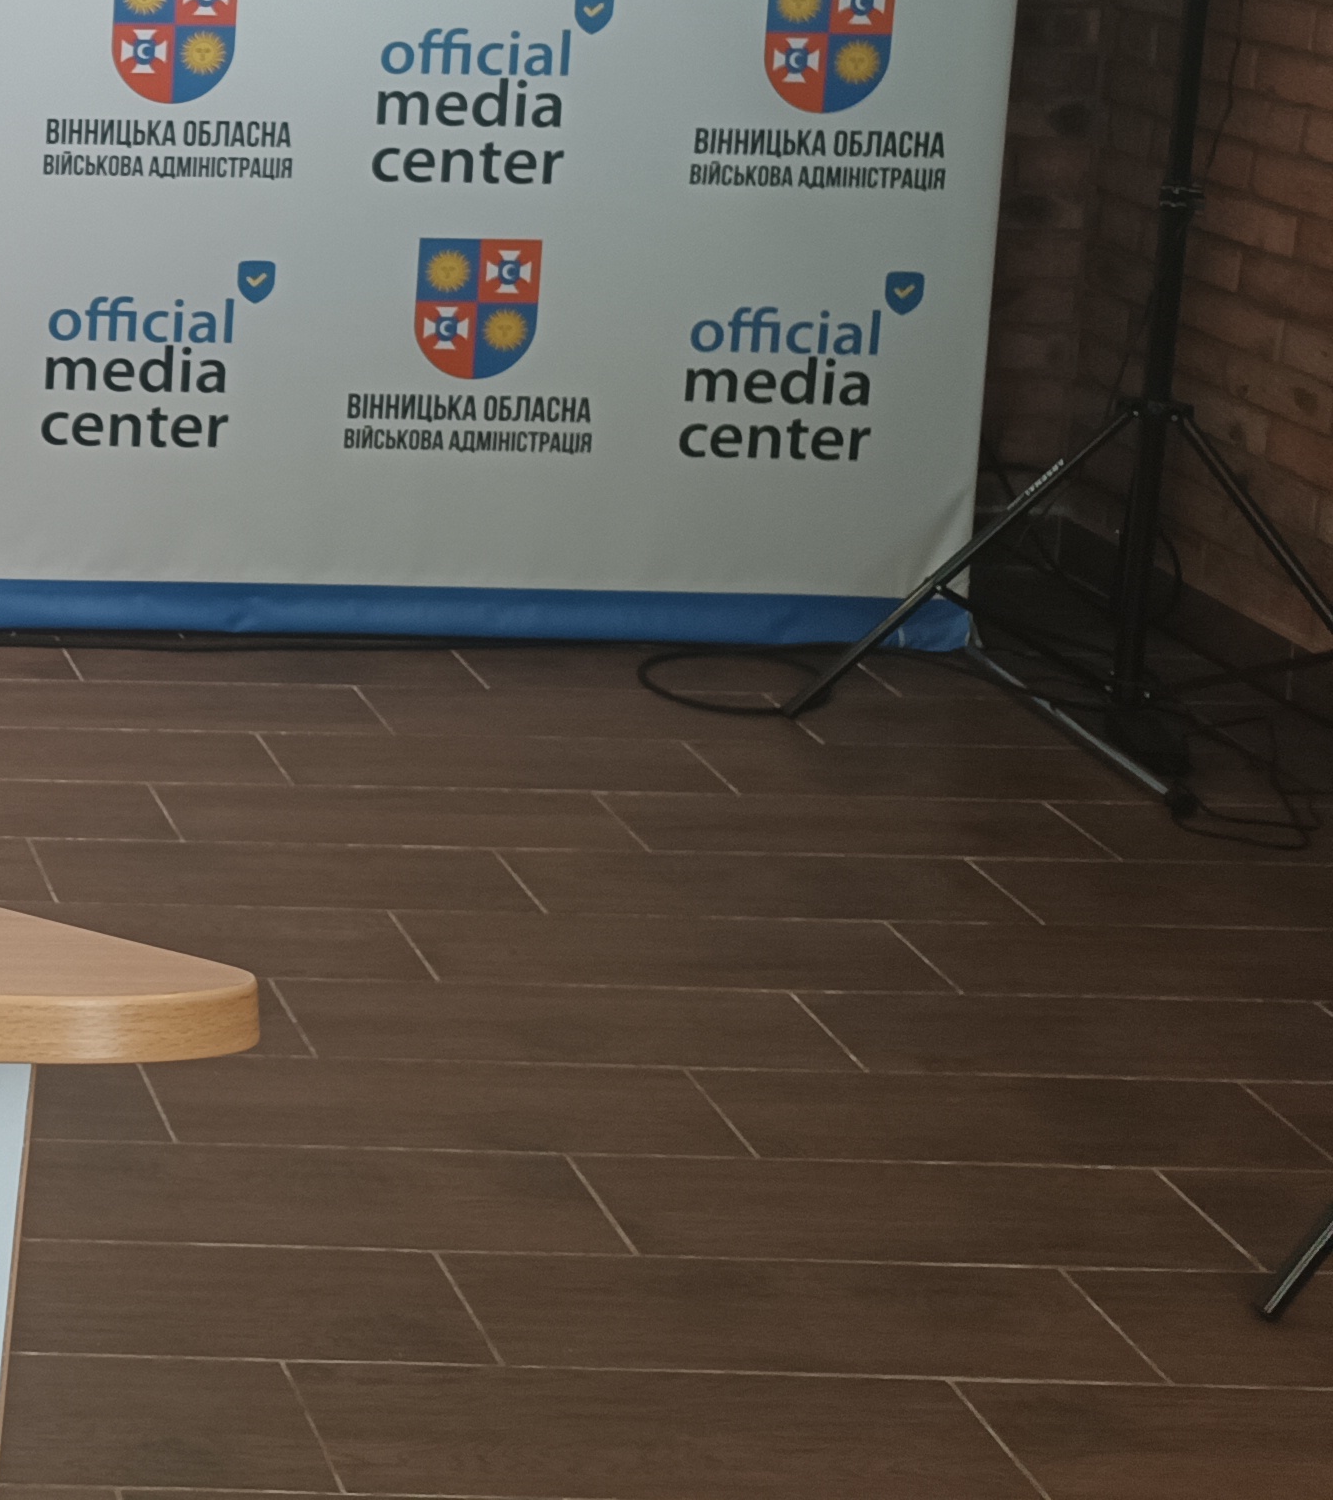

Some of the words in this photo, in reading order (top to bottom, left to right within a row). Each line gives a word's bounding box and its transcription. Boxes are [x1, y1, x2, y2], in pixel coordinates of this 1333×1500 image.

[381, 28, 571, 76] official
[377, 78, 562, 128] media
[46, 119, 176, 148] ВІННИЦЬКА
[183, 120, 291, 147] ОБЛАСНА
[694, 128, 826, 158] ВІННИЦЬКА
[834, 130, 944, 158] ОБЛАСНА
[43, 151, 143, 176] ВІЙСЬКОВА
[149, 156, 292, 180] АДМІНІСТРАЦІЯ
[372, 142, 564, 184] center
[689, 161, 792, 187] ВІЙСЬКОВА
[798, 166, 946, 192] АДМІНІСТРАЦІЯ
[49, 296, 234, 343] official
[690, 306, 881, 356] official
[45, 345, 226, 393] media
[685, 356, 870, 406] media
[41, 407, 229, 448] center
[347, 393, 476, 423] ВІННИЦЬКА
[484, 395, 591, 423] ОБЛАСНА
[344, 425, 443, 450] ВІЙСЬКОВА
[449, 430, 592, 455] АДМІНІСТРАЦІЯ
[679, 418, 871, 461] center
